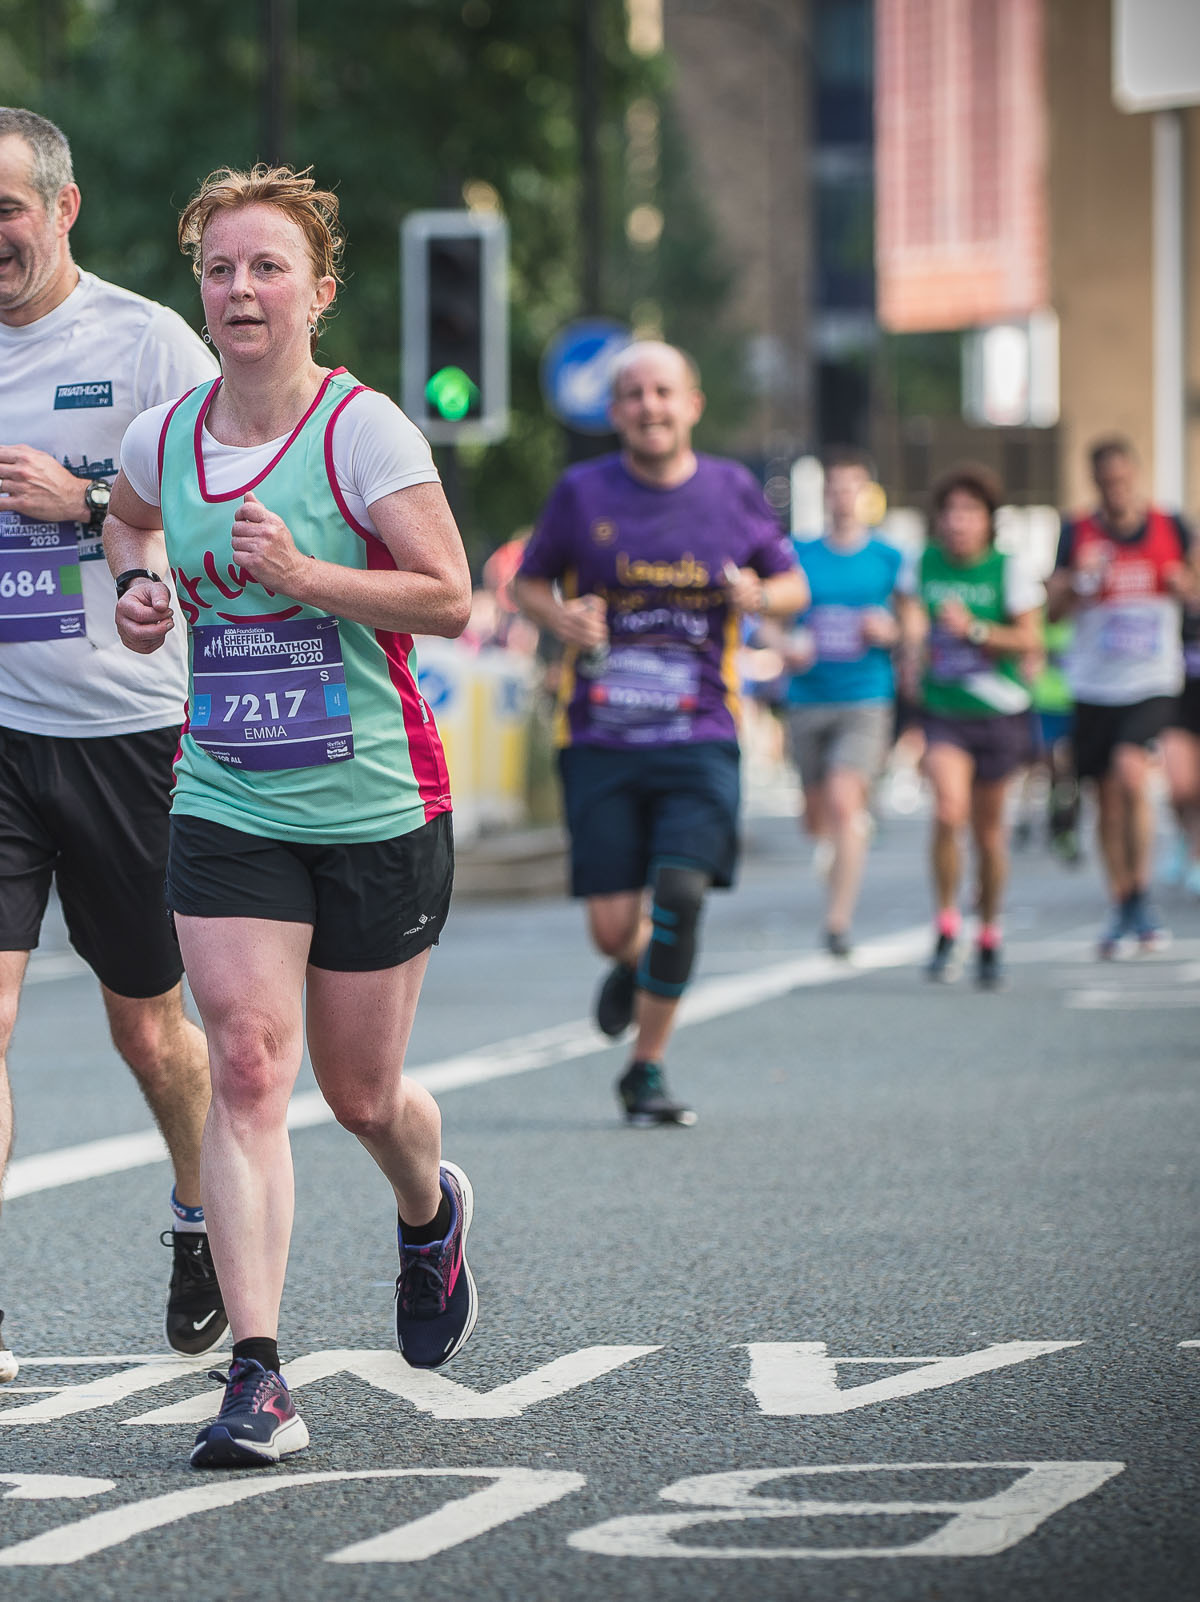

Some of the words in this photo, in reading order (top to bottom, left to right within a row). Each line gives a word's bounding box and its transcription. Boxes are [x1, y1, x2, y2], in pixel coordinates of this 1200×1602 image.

[58, 384, 110, 398] TRIATHLON
[29, 535, 60, 546] 2020
[224, 633, 273, 646] SHEFFIELD
[225, 645, 250, 657] HALF
[251, 640, 322, 656] MARATHON
[290, 651, 324, 665] 2020
[319, 671, 330, 682] S
[223, 689, 307, 723] 7217
[244, 725, 288, 740] EMMA
